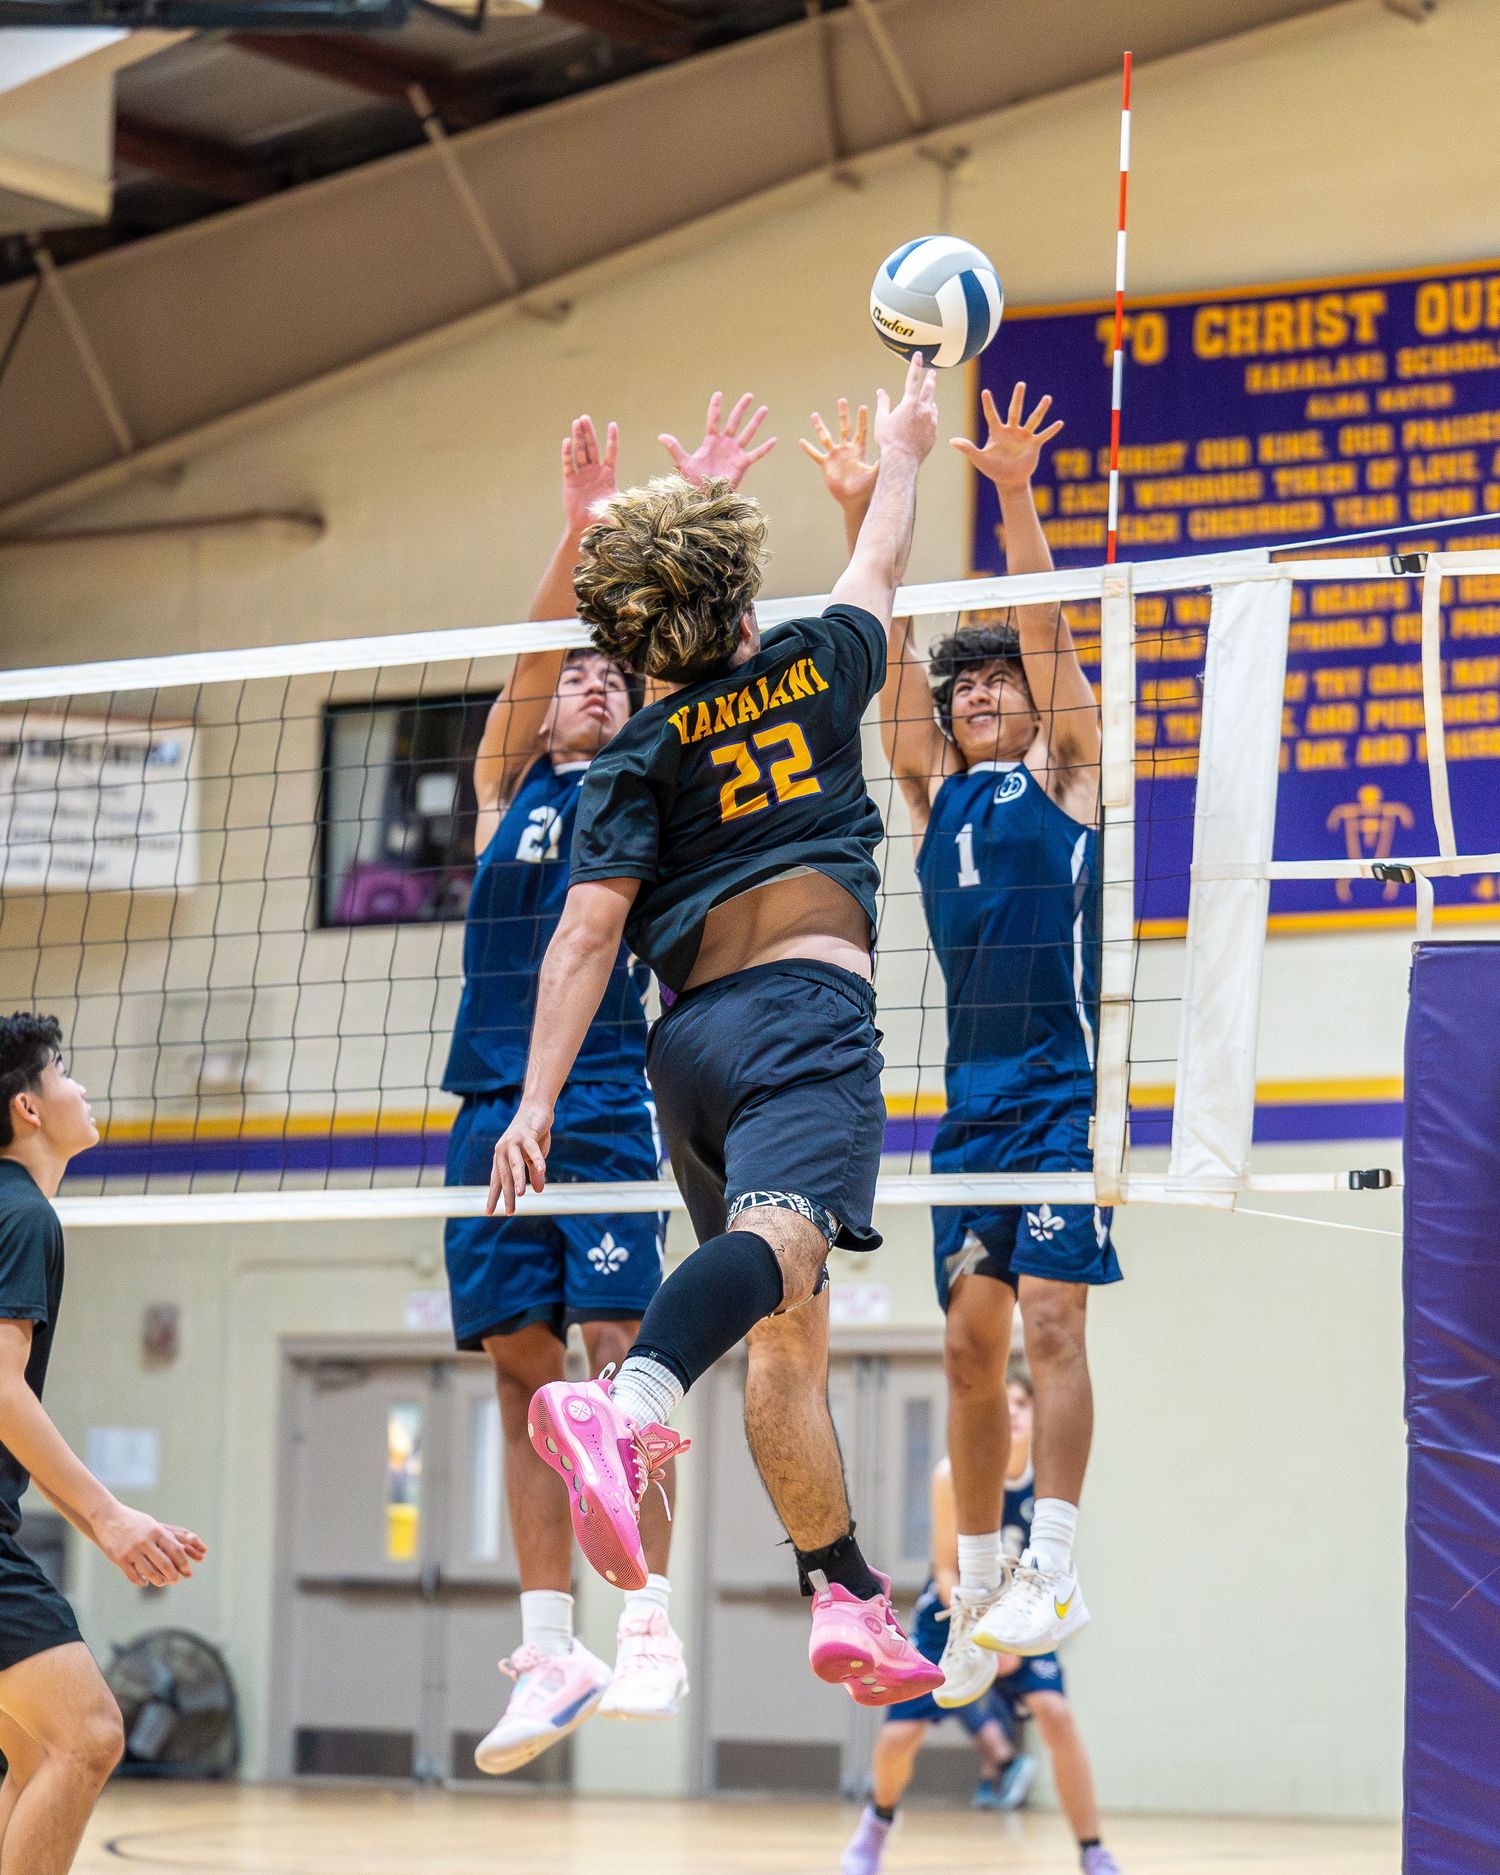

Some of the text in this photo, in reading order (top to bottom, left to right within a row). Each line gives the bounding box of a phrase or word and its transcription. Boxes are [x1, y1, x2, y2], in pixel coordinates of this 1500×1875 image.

[873, 306, 915, 337] Baden
[1096, 312, 1167, 367] TO
[1194, 290, 1387, 359] CHRIST
[710, 721, 823, 824] 22
[954, 822, 982, 888] 1
